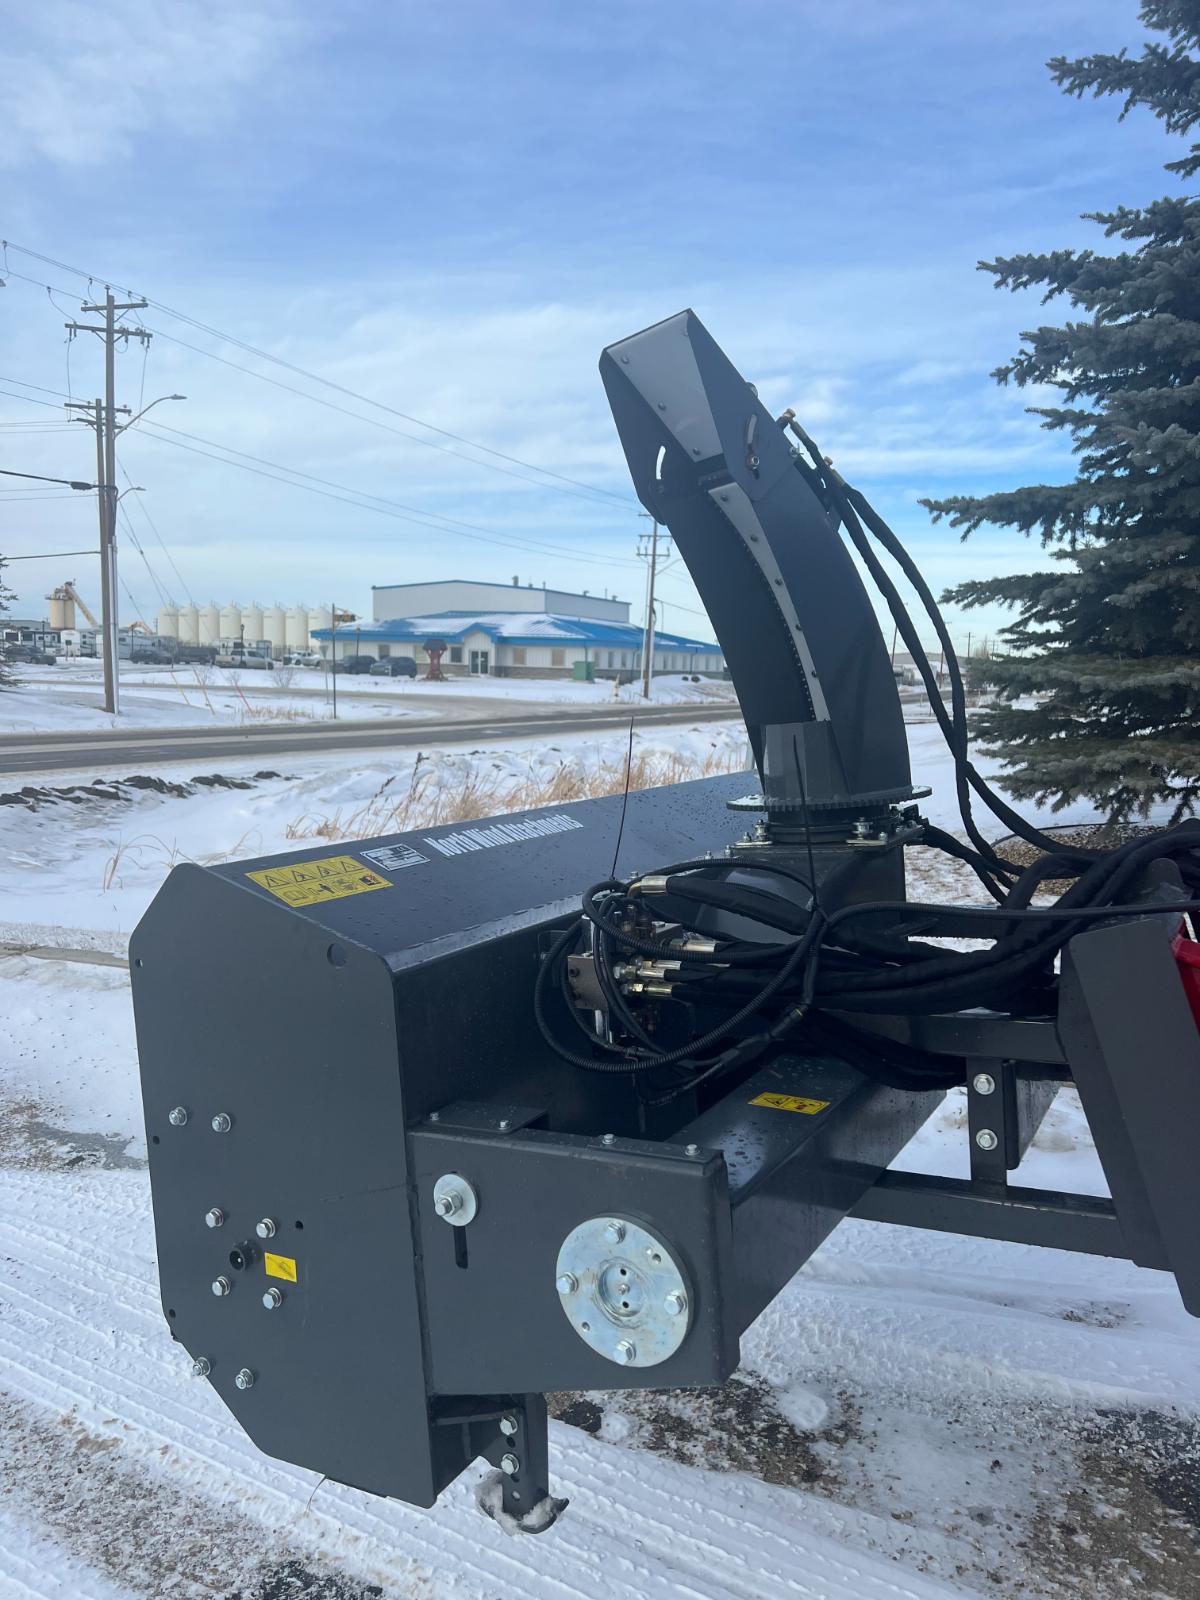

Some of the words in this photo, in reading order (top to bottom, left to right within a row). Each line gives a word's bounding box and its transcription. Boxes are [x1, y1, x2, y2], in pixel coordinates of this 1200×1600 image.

[422, 832, 483, 856] North
[461, 825, 515, 848] Wind
[495, 814, 584, 841] Attachments
